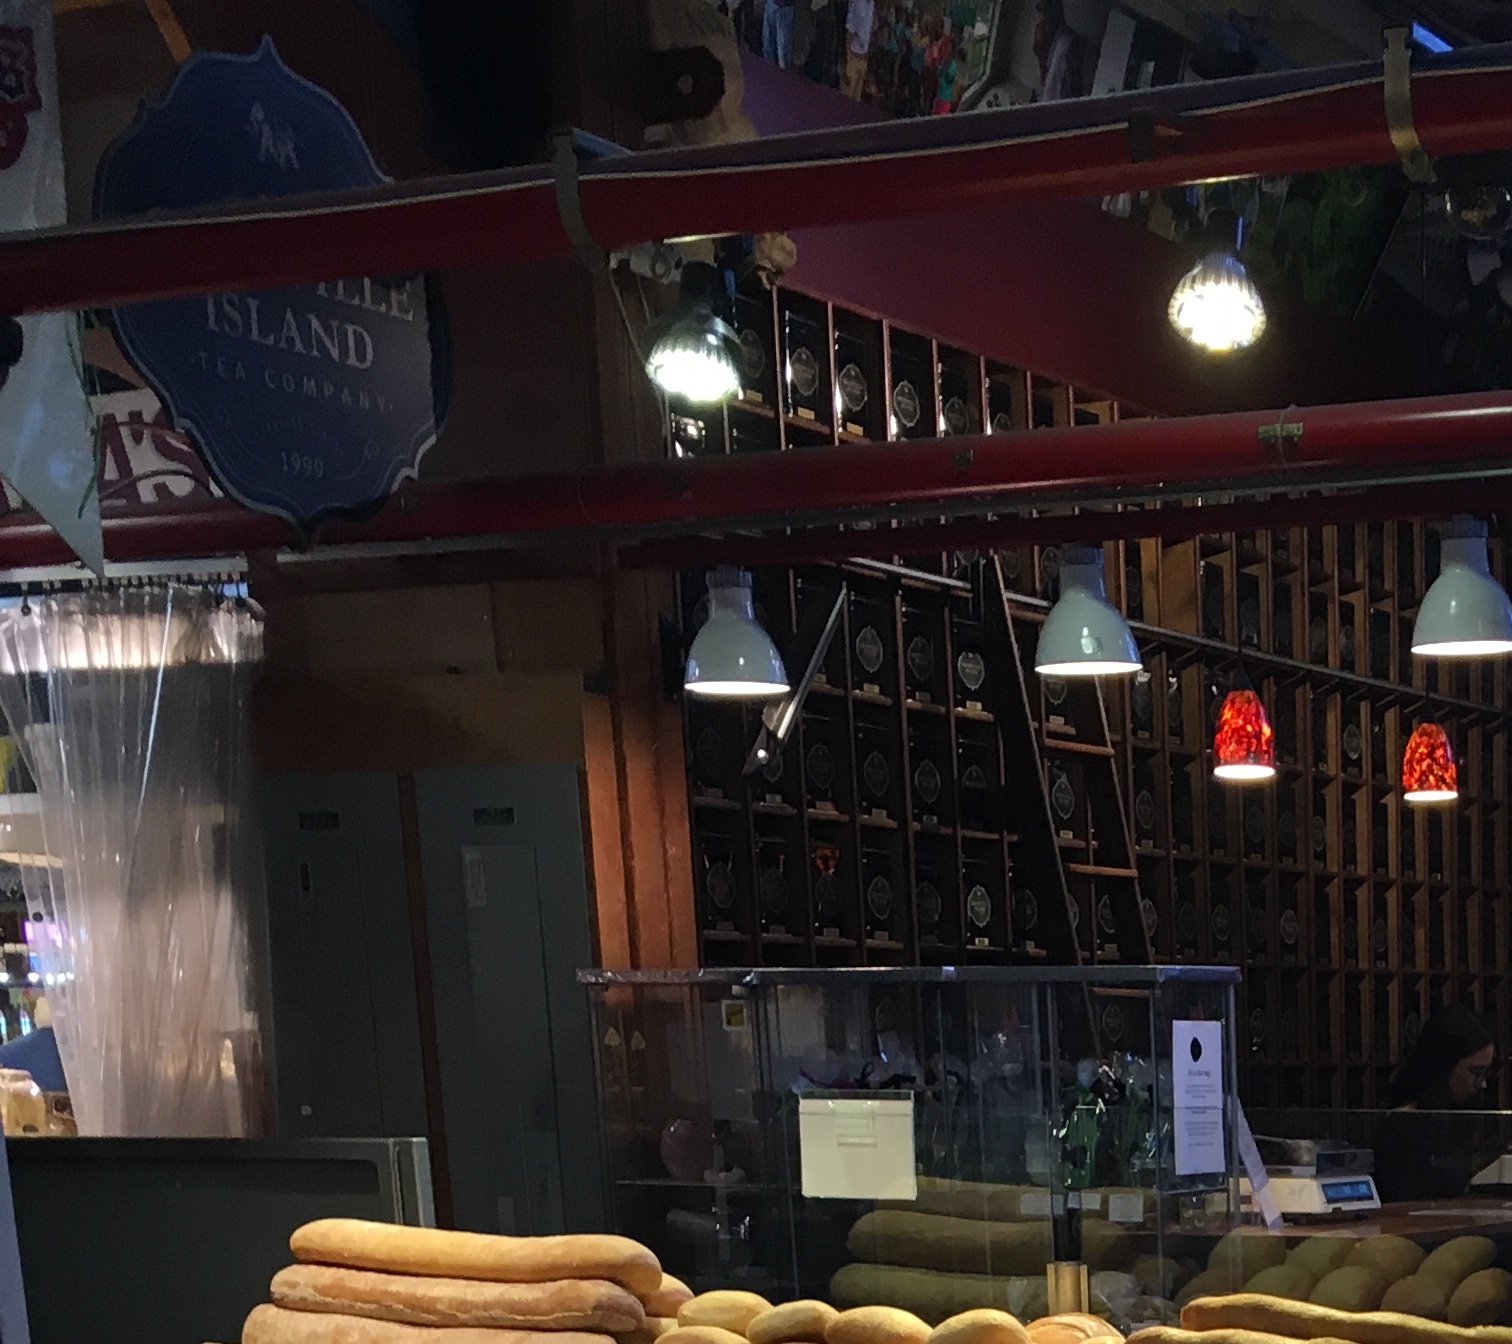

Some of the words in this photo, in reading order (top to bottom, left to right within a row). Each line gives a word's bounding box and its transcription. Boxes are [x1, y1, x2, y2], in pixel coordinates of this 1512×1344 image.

[205, 293, 375, 370] ISLAND
[197, 350, 247, 381] TEA
[264, 367, 388, 412] COMPANY
[279, 450, 325, 479] 1999
